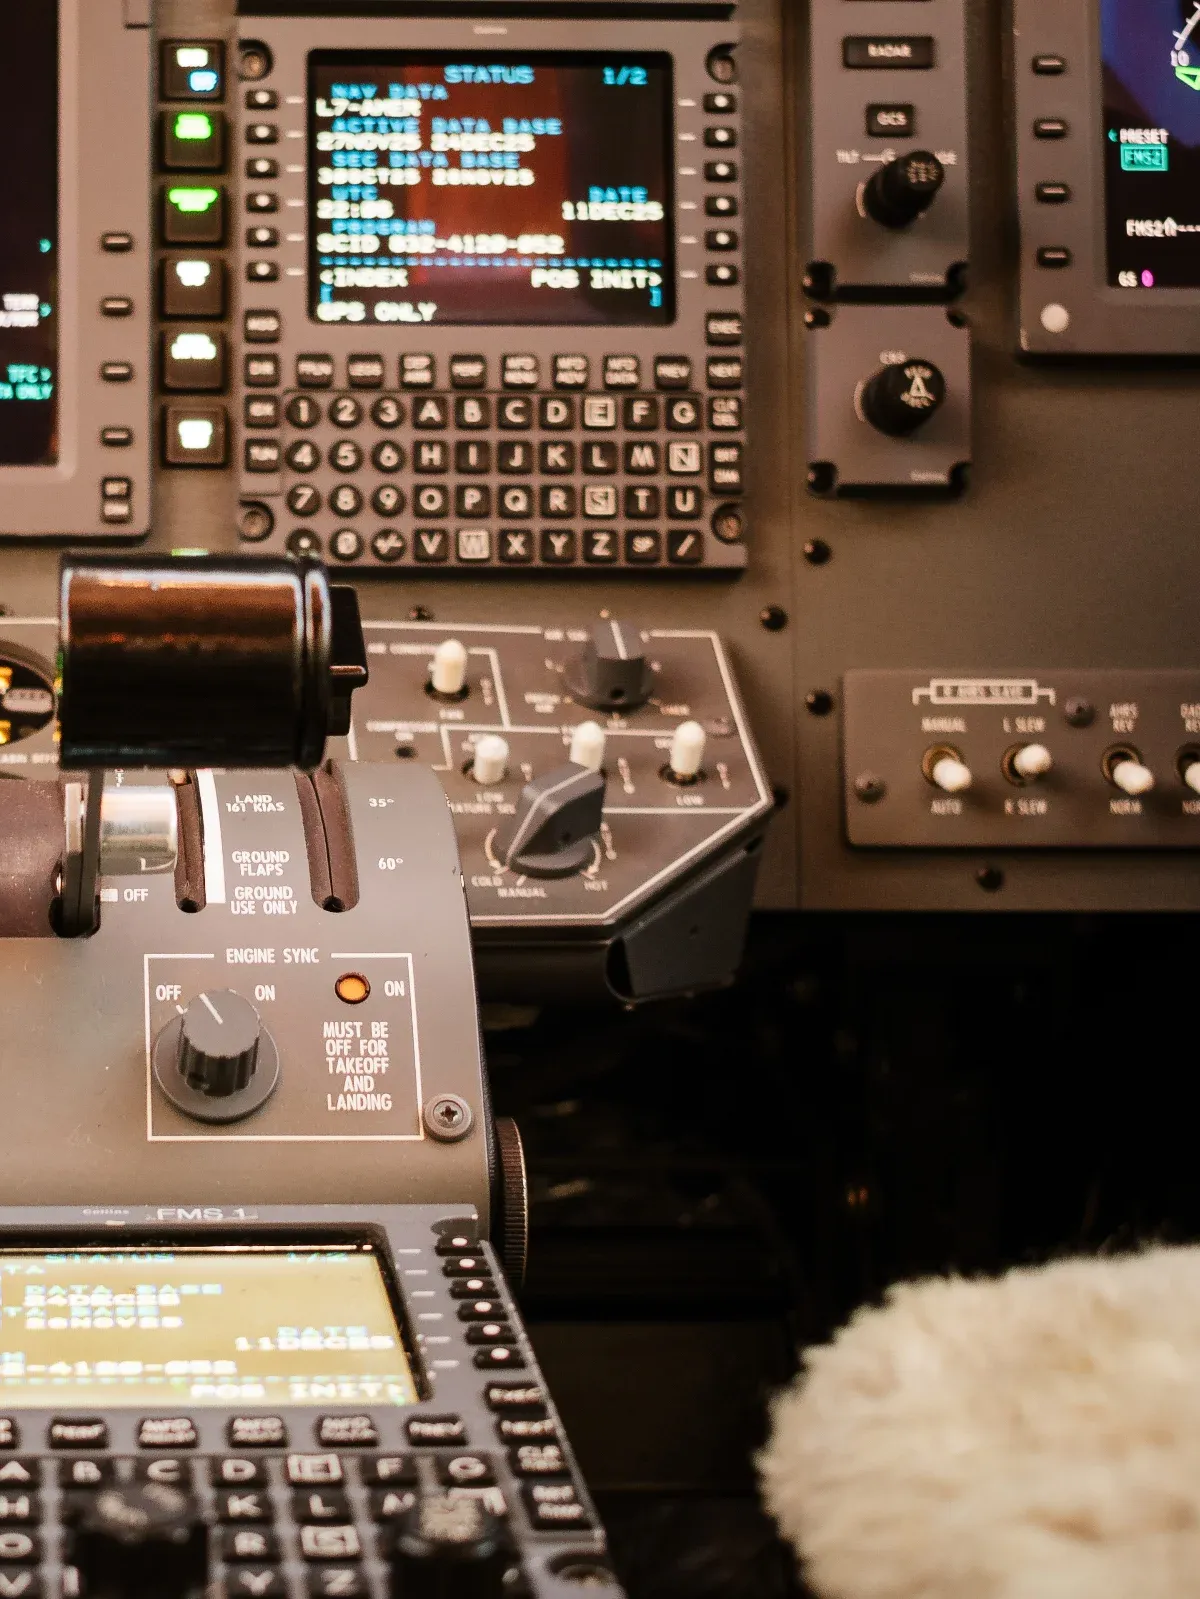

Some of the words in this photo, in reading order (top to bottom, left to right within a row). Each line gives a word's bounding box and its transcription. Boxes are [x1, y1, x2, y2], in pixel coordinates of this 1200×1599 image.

[444, 65, 535, 84] STATUS
[603, 66, 648, 85] 1/2
[331, 83, 377, 99] NAV
[389, 83, 448, 100] DATA
[332, 117, 419, 133] ACTIVE
[432, 117, 491, 133] DATA
[502, 117, 562, 135] BASE
[1120, 128, 1169, 144] PRESET
[332, 151, 377, 167] SEC
[389, 151, 449, 168] DATA
[461, 151, 520, 168] BASE
[588, 185, 648, 202] DATE
[1142, 269, 1154, 287] 0
[300, 400, 309, 423] 1
[337, 399, 355, 421] 2
[379, 400, 398, 422] 3
[419, 400, 441, 422] A
[464, 400, 481, 422] B
[505, 401, 525, 423] C
[547, 401, 568, 423] D
[633, 401, 649, 423] F
[673, 401, 695, 424] G
[294, 444, 313, 466] 4
[337, 444, 356, 465] 5
[379, 445, 398, 466] 6
[421, 444, 441, 465] H
[509, 445, 523, 467] J
[547, 445, 566, 467] K
[592, 445, 607, 467] L
[630, 445, 654, 467] M
[295, 488, 314, 509] 7
[337, 488, 355, 510] 8
[378, 488, 398, 510] 9
[419, 488, 443, 511] O
[464, 488, 481, 510] P
[504, 488, 528, 512] Q
[549, 488, 568, 511] R
[634, 489, 650, 511] T
[675, 490, 695, 512] U
[420, 533, 441, 554] V
[507, 533, 525, 555] X
[549, 533, 568, 556] Y
[592, 533, 612, 556] Z
[226, 803, 246, 812] 161
[254, 802, 285, 812] KIAS
[236, 795, 272, 804] LAND
[232, 851, 289, 864] GROUND
[240, 864, 283, 876] FLAPS
[124, 889, 148, 901] OFF
[234, 886, 292, 900] GROUND
[231, 901, 258, 914] USE
[263, 901, 298, 914] ONLY
[226, 949, 276, 964] ENGINE
[283, 948, 319, 963] SYNC
[156, 986, 181, 1000] OFF
[254, 985, 275, 1001] ON
[384, 981, 405, 997] ON
[323, 1022, 364, 1038] MUST
[371, 1022, 389, 1038] BE
[325, 1040, 352, 1056] OFF
[360, 1040, 387, 1056] FOR
[326, 1058, 389, 1074] TAKEOFF
[344, 1076, 374, 1092] AND
[327, 1094, 392, 1111] LANDING
[157, 1208, 223, 1220] FMS
[309, 1494, 336, 1516] L
